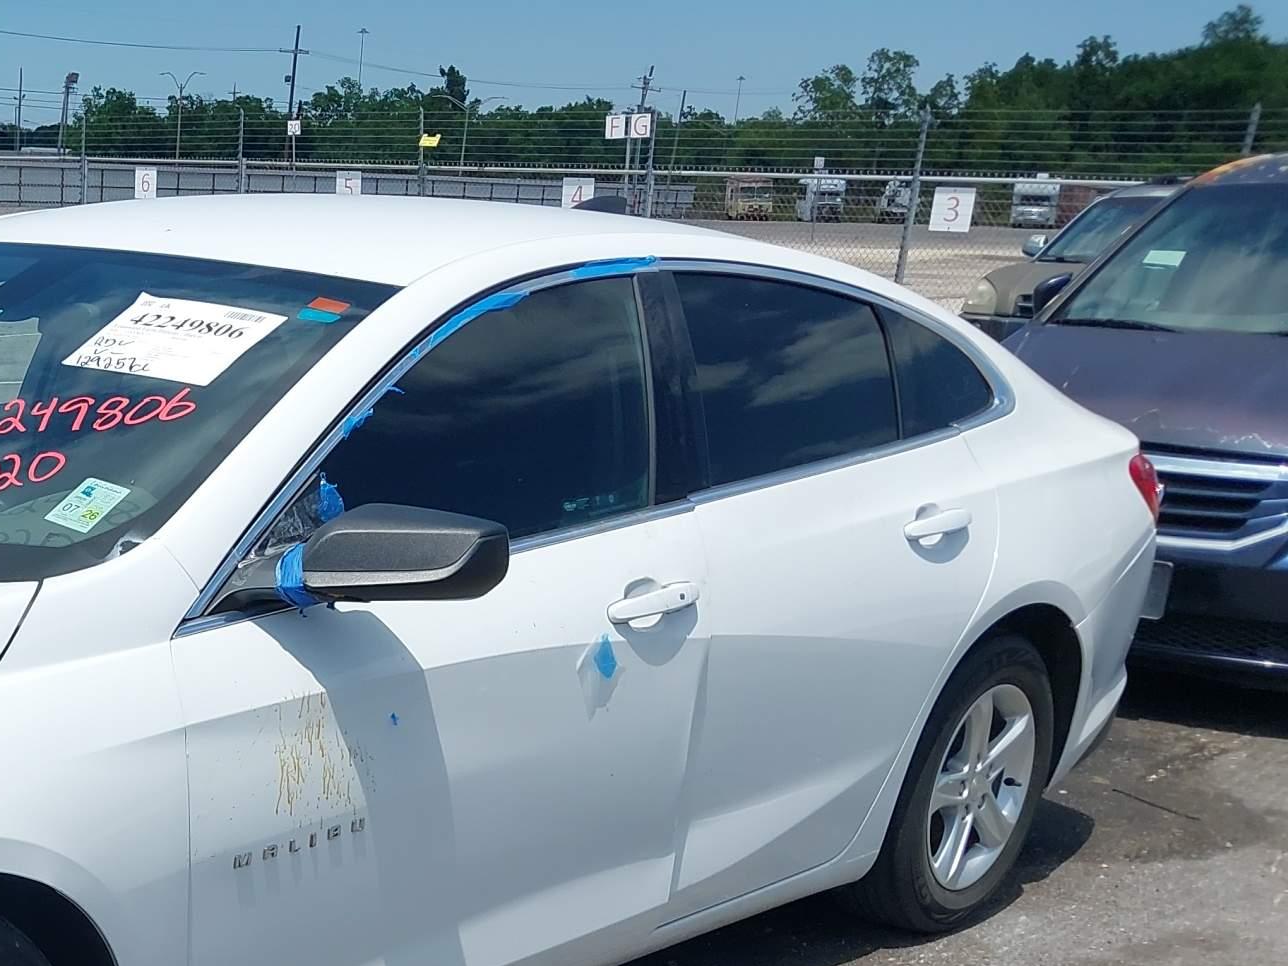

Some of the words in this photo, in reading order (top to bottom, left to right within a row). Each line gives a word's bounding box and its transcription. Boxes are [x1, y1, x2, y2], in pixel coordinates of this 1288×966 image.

[288, 122, 300, 134] 20
[610, 117, 621, 138] F
[633, 115, 648, 137] G
[140, 173, 150, 192] 6
[344, 178, 353, 195] 5
[570, 185, 583, 203] 4
[943, 196, 960, 222] 3
[130, 312, 251, 339] 42249806
[62, 502, 80, 513] 07
[81, 509, 99, 521] 26
[232, 817, 366, 870] MALIBU
